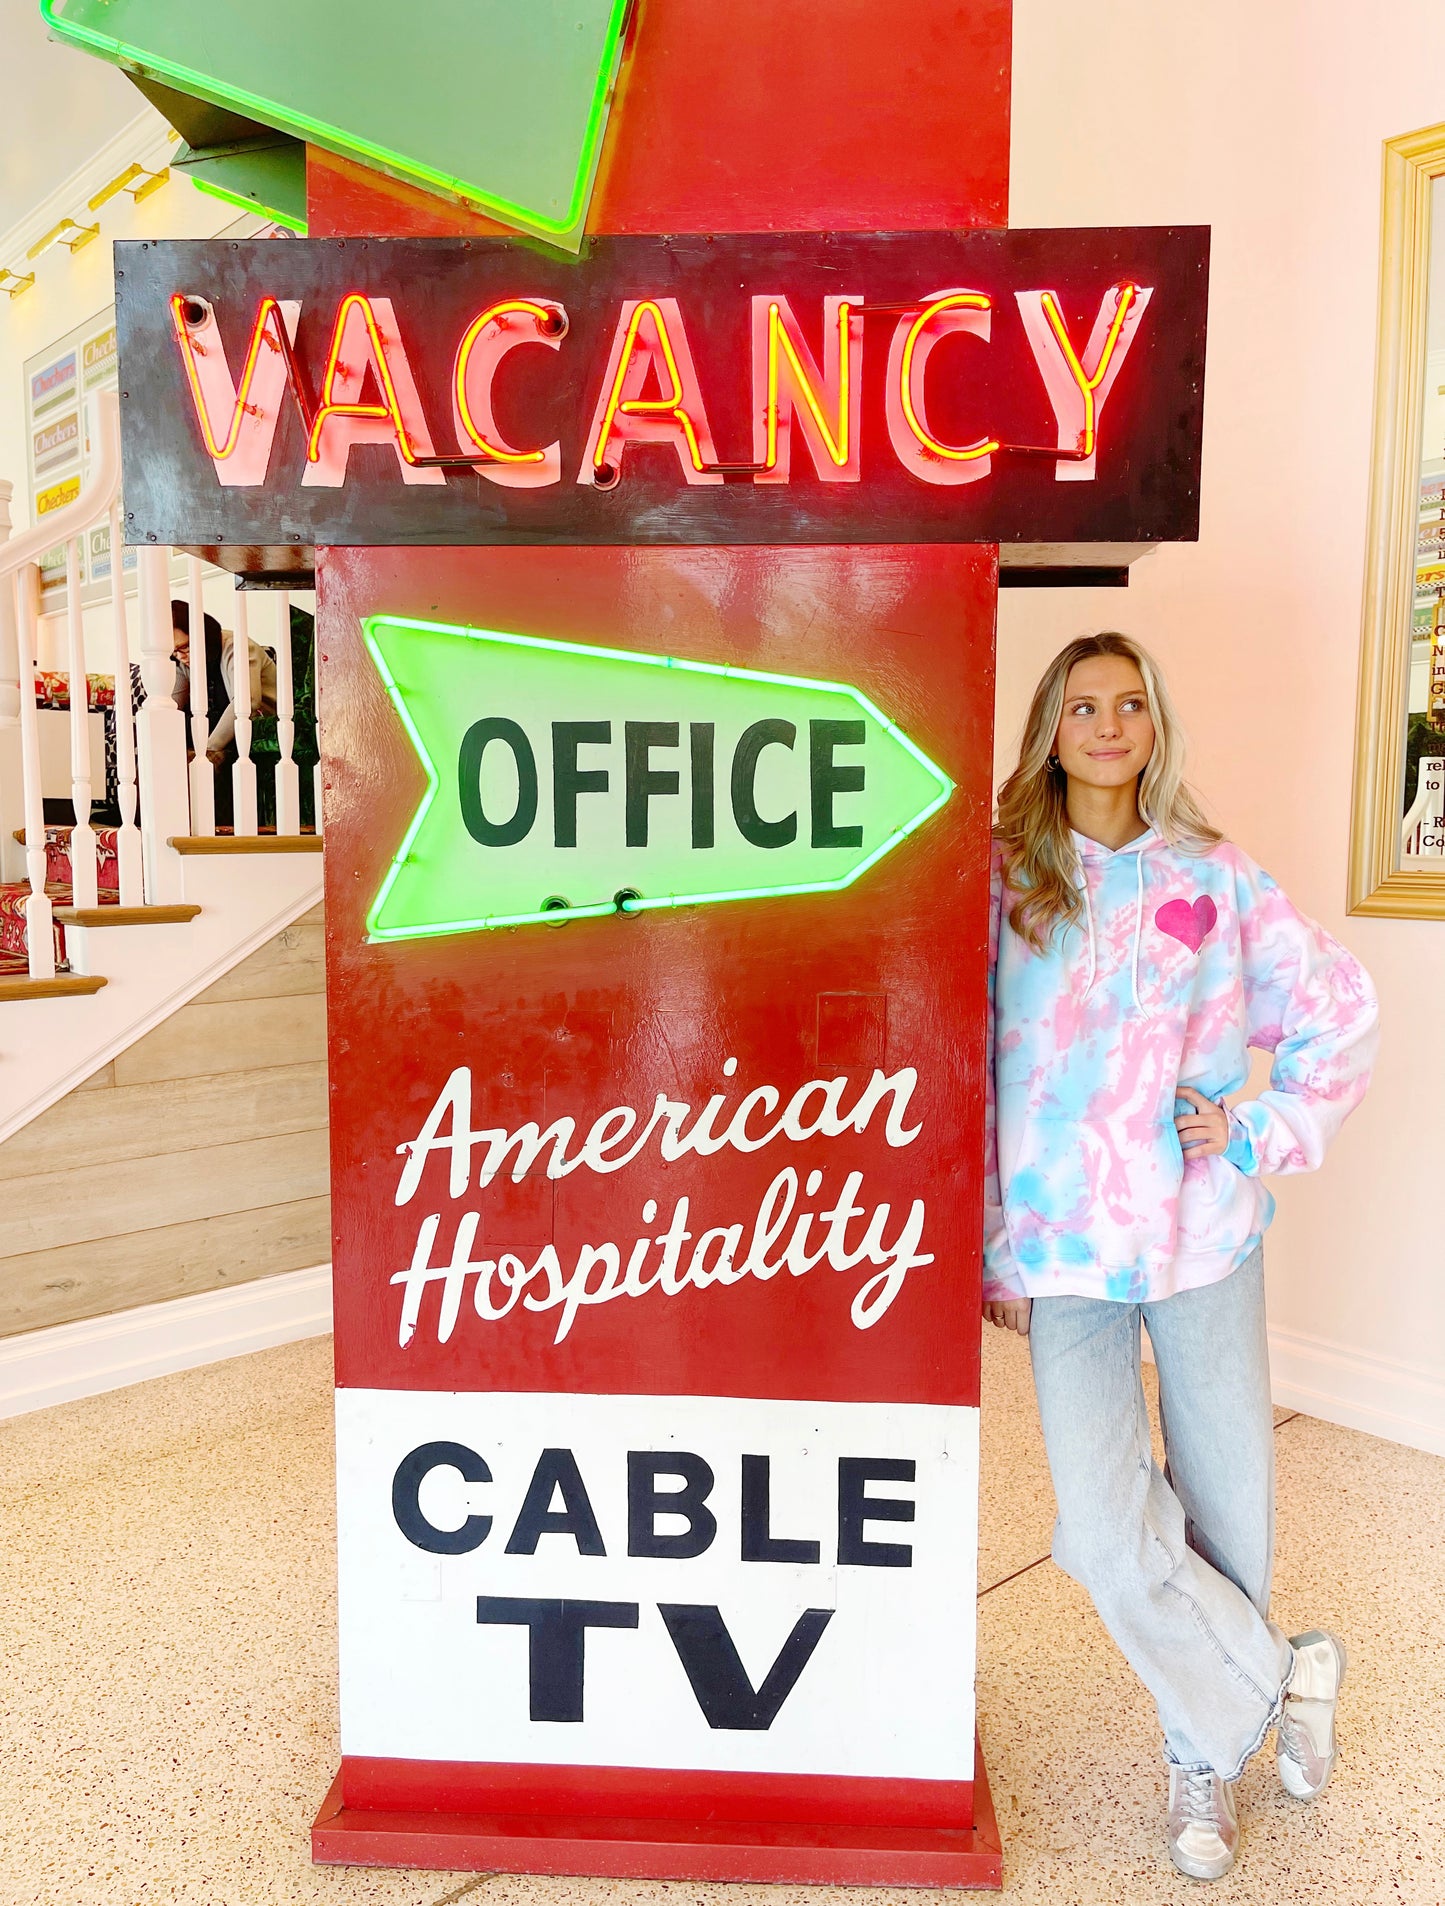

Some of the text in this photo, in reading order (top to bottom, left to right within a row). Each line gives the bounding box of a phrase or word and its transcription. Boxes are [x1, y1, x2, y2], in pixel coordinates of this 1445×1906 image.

[32, 362, 76, 399] Checkers
[36, 423, 78, 455] Checkers
[171, 284, 1153, 488] VACANCY
[38, 486, 80, 515] Checkers
[458, 717, 866, 849] OFFICE
[1426, 780, 1440, 791] to
[395, 1057, 923, 1207] American
[390, 1167, 935, 1349] Hospitality
[391, 1440, 916, 1568] CABLE
[476, 1595, 836, 1731] TV
